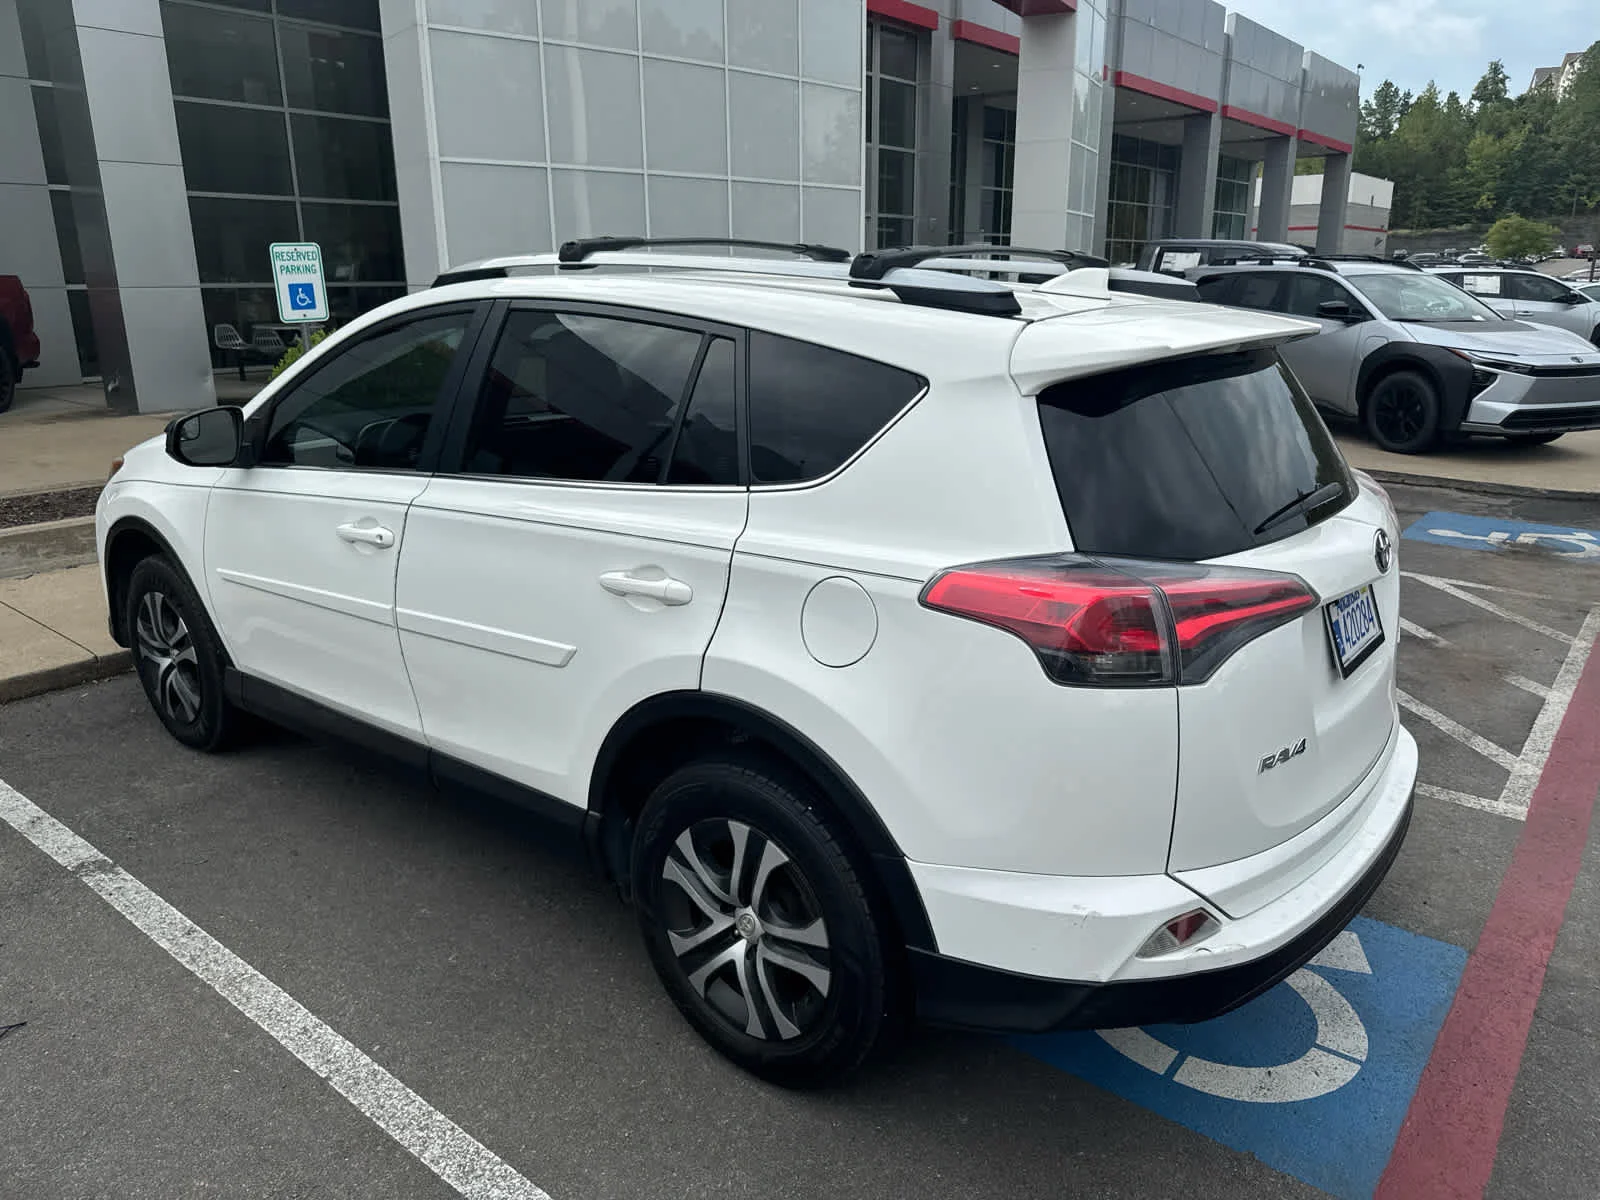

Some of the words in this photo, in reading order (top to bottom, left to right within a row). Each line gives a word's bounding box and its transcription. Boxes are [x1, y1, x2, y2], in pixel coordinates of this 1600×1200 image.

[275, 251, 317, 261] RESERVED
[280, 264, 317, 274] PARKING
[1257, 737, 1306, 775] RAV4
